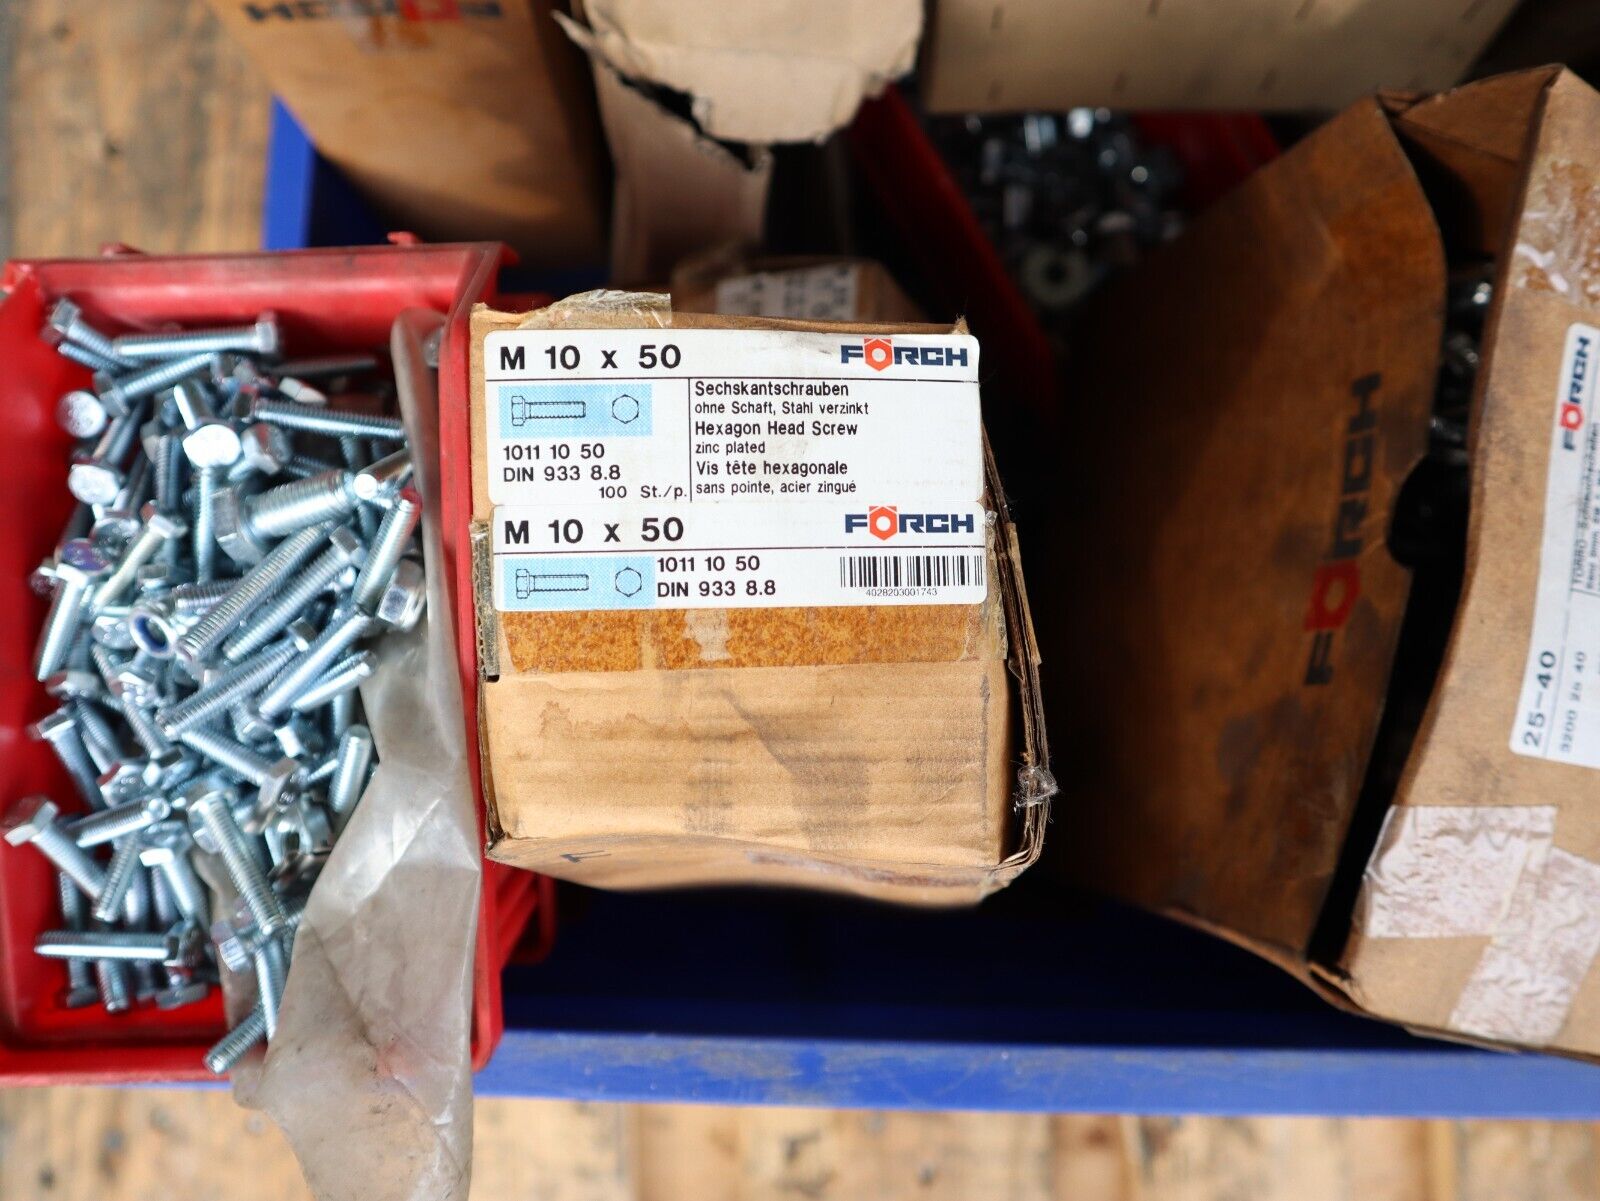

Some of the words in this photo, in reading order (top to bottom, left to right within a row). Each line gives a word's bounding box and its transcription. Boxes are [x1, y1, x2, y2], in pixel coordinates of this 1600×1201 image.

[500, 346, 525, 370] M
[544, 345, 580, 370] 10
[601, 350, 618, 369] x
[638, 344, 682, 369] 50
[695, 381, 849, 396] Sechskantschrauben
[695, 403, 725, 415] ohne
[731, 402, 776, 416] Schaft,
[782, 402, 813, 414] Stahl
[819, 402, 869, 415] verzinkt
[695, 421, 761, 437] Hexagon
[767, 421, 804, 435] Head
[811, 421, 858, 436] Screw
[503, 445, 541, 460] 1011
[550, 444, 570, 459] 10
[580, 443, 605, 459] 50
[695, 442, 720, 454] zinc
[725, 442, 766, 458] plated
[504, 467, 534, 482] DIN
[544, 466, 581, 481] 933
[590, 464, 621, 481] 8.8
[696, 461, 719, 475] Vis
[726, 460, 756, 475] tête
[763, 460, 848, 479] hexagonale
[600, 486, 627, 499] 100
[640, 485, 687, 500] St./p.
[696, 483, 725, 494] sans
[731, 481, 774, 498] pointe,
[780, 481, 811, 493] acier
[818, 480, 857, 497] zingué
[505, 520, 529, 544] M
[548, 519, 583, 544] 10
[604, 524, 621, 542] x
[641, 517, 684, 542] 50
[657, 557, 695, 573] 1011
[705, 556, 725, 572] 10
[736, 555, 760, 571] 50
[657, 582, 689, 597] DIN
[699, 581, 736, 597] 933
[746, 580, 776, 596] 8.8
[865, 588, 938, 597] 4028203001743
[1574, 651, 1587, 673] 40
